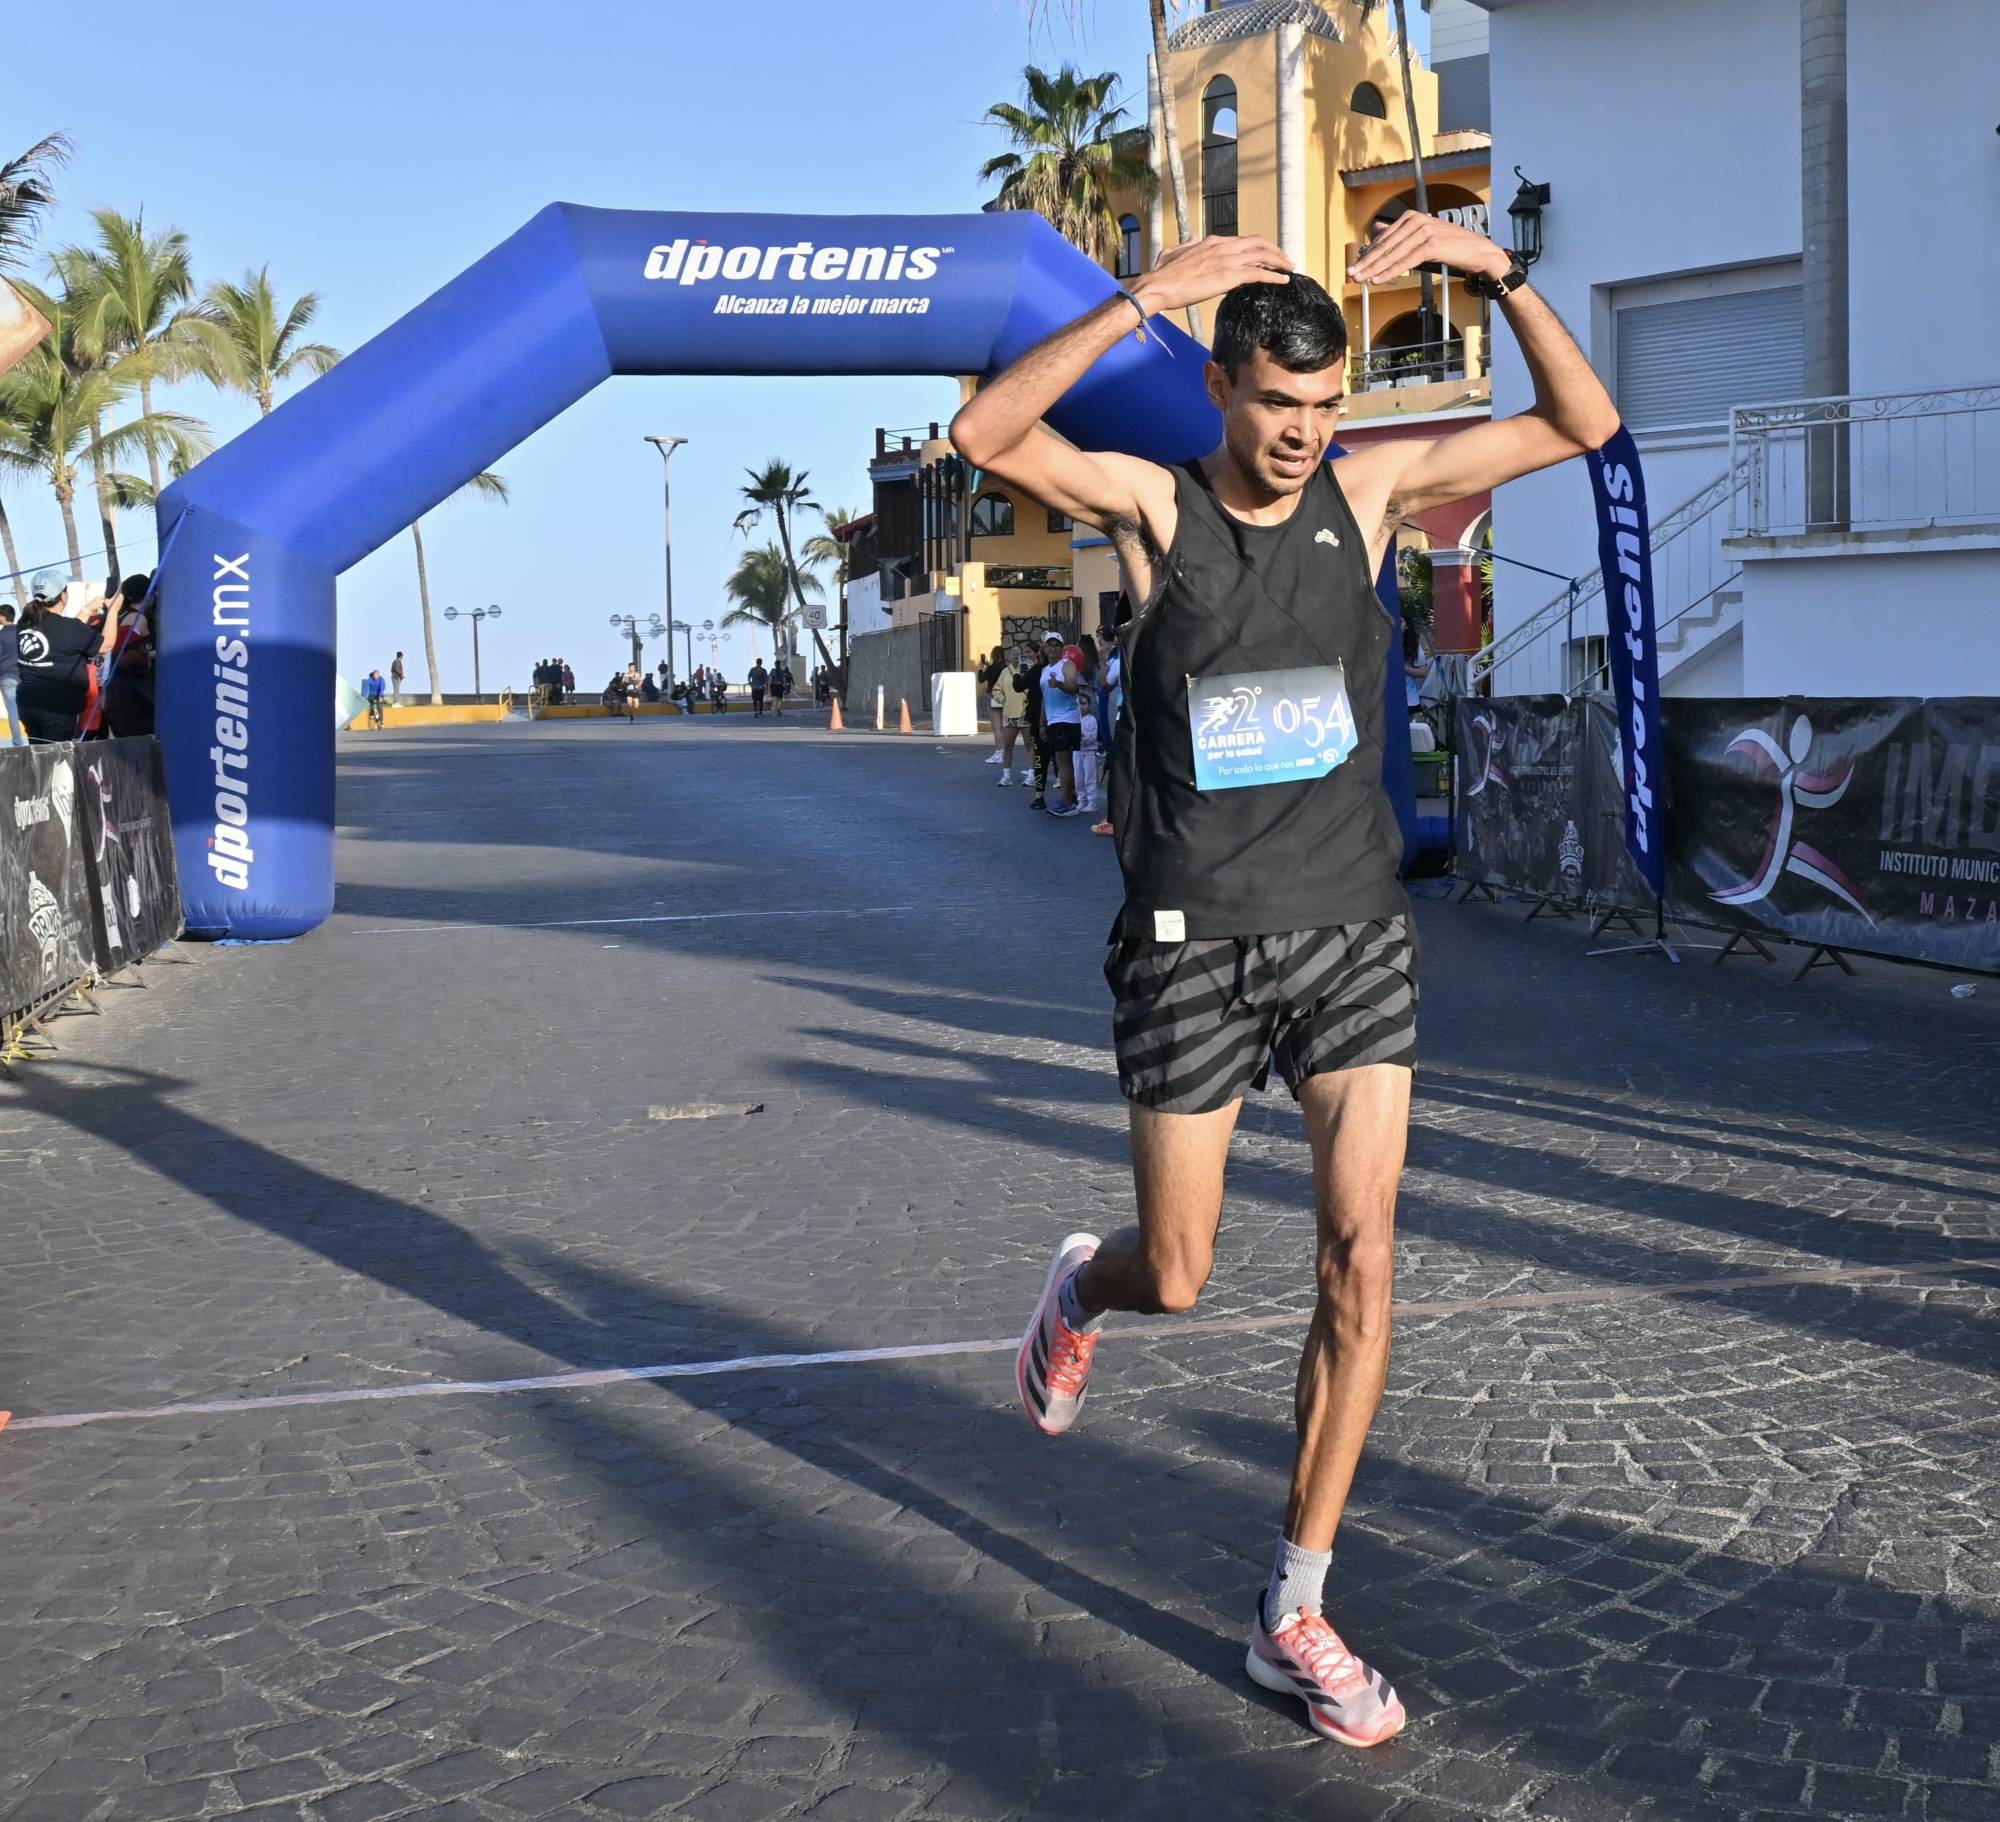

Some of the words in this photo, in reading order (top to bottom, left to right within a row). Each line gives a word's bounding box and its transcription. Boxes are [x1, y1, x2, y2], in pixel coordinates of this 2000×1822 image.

[643, 239, 941, 286] dportenis
[713, 295, 786, 315] Alcanza
[790, 295, 808, 314] la
[811, 294, 867, 316] mejor
[869, 298, 930, 315] marca
[809, 611, 820, 620] 40
[1603, 463, 1653, 853] dportenis
[207, 552, 254, 891] dportenis.mx
[1273, 692, 1352, 748] 054
[1197, 731, 1266, 750] CARRERA
[1207, 751, 1223, 761] por
[1225, 749, 1234, 758] la
[1236, 747, 1263, 758] salud
[1218, 766, 1231, 776] Por
[1234, 764, 1253, 774] todo
[1255, 763, 1263, 772] lo
[1264, 762, 1279, 772] que
[1280, 760, 1294, 769] nos
[1879, 850, 1948, 878] INSTITUTO
[1951, 857, 2000, 884] MUNIC
